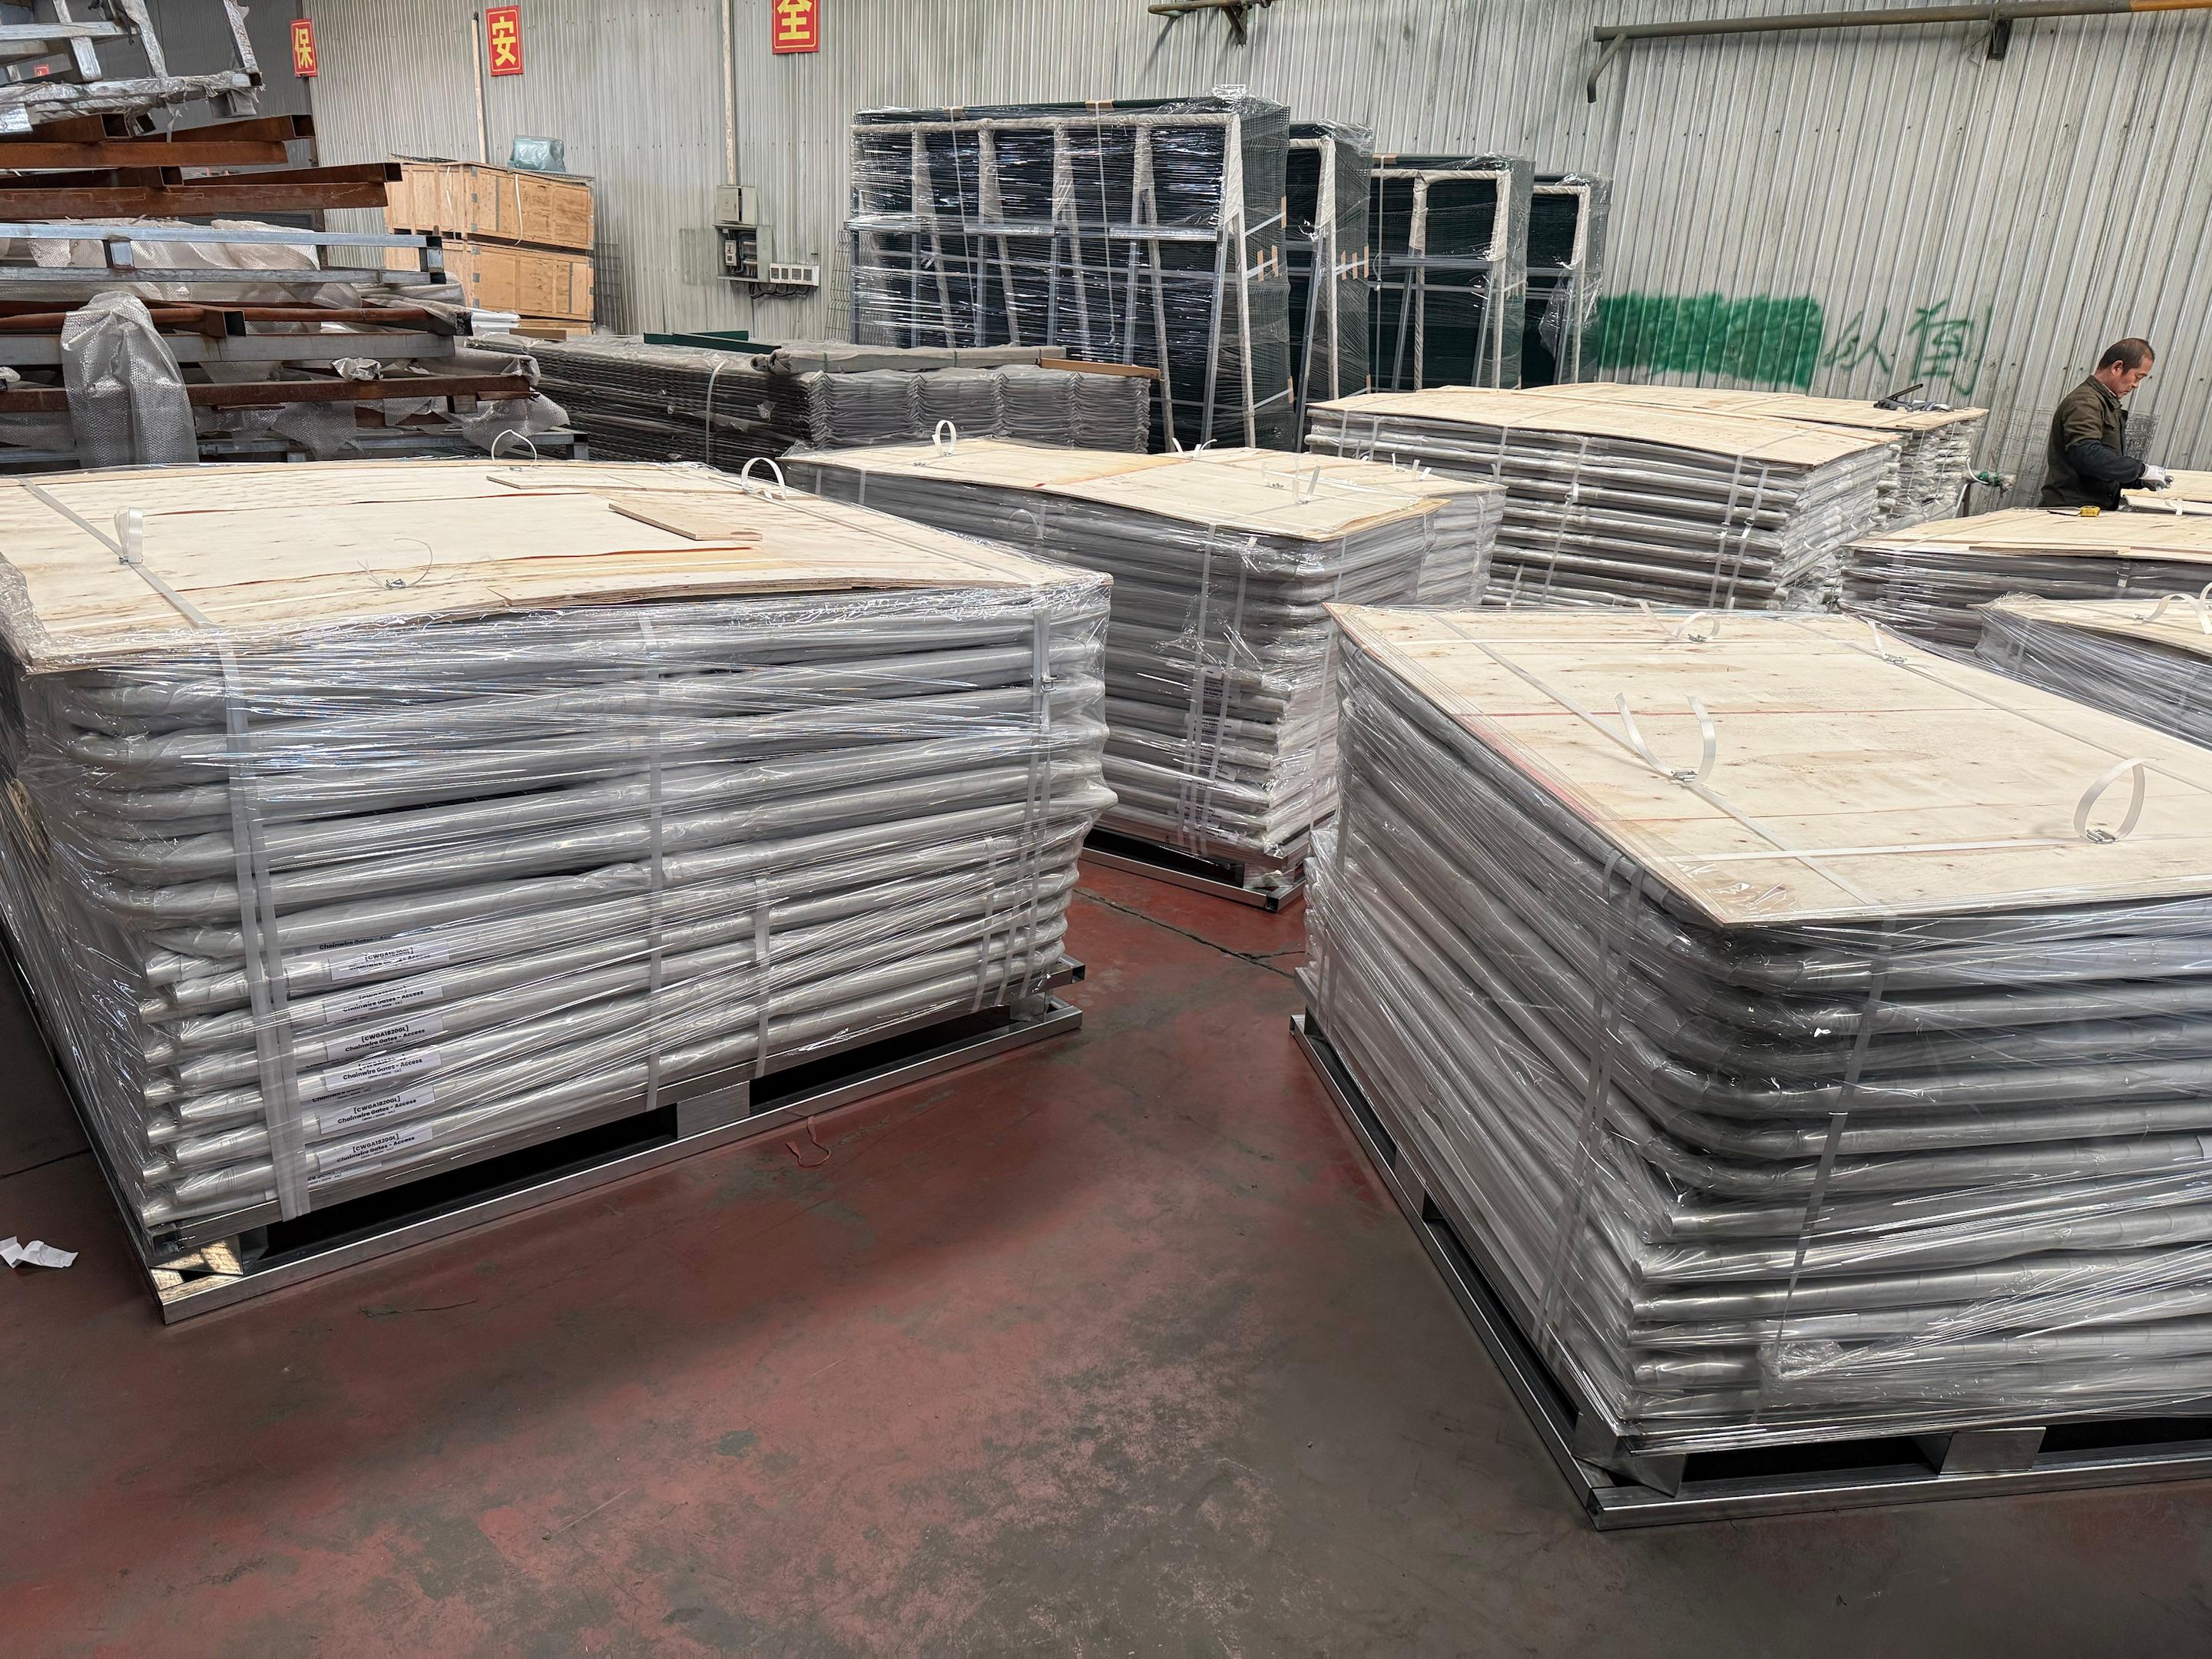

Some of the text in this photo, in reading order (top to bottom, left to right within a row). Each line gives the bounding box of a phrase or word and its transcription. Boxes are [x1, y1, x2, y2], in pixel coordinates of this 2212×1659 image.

[777, 0, 813, 40] 全
[294, 27, 313, 68] 保
[492, 16, 517, 67] 安
[319, 940, 354, 950] Chainwire
[401, 990, 424, 1000] Access
[345, 1039, 379, 1052] Chainwire
[379, 1035, 398, 1045] Gates
[402, 1028, 426, 1038] Access
[361, 1025, 409, 1043] [CWGA1820GL]
[343, 1068, 376, 1081] Chainwire
[400, 1058, 422, 1068] Access
[338, 1111, 370, 1124] Chainwire
[370, 1106, 389, 1115] Gates
[395, 1098, 417, 1108] Access
[353, 1095, 400, 1114] [CWGA1820GL]
[336, 1150, 369, 1163] Chainwire
[369, 1144, 389, 1153] Gates
[393, 1136, 416, 1147] Access
[353, 1133, 399, 1153] [CWGA1820GL]
